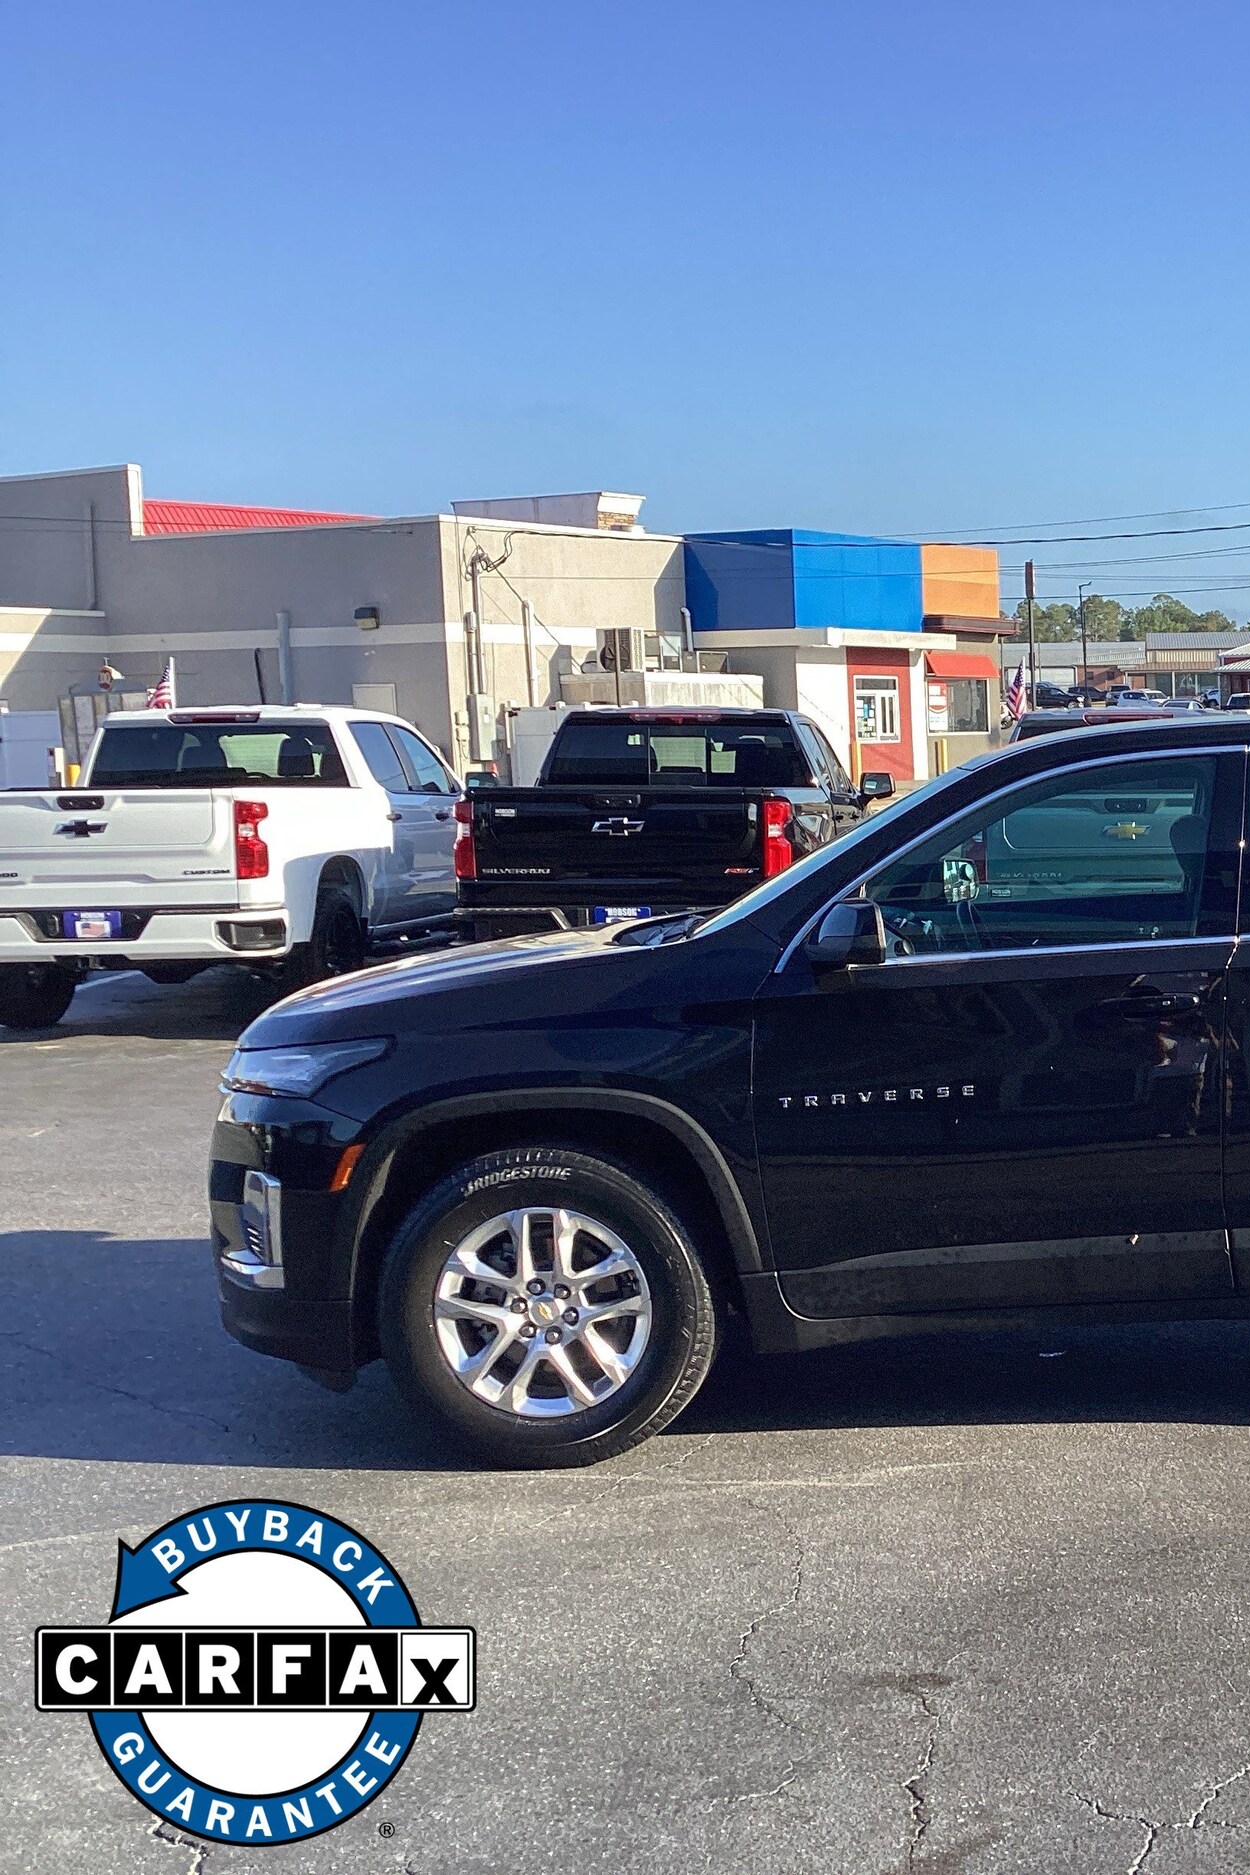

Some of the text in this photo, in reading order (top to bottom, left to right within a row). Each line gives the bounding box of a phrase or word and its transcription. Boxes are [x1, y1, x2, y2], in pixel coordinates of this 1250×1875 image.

[182, 868, 231, 876] CUSTOM
[607, 907, 638, 917] HOBSON
[778, 1085, 975, 1109] TRAVERSE
[461, 1164, 574, 1198] BRIDGESTONE
